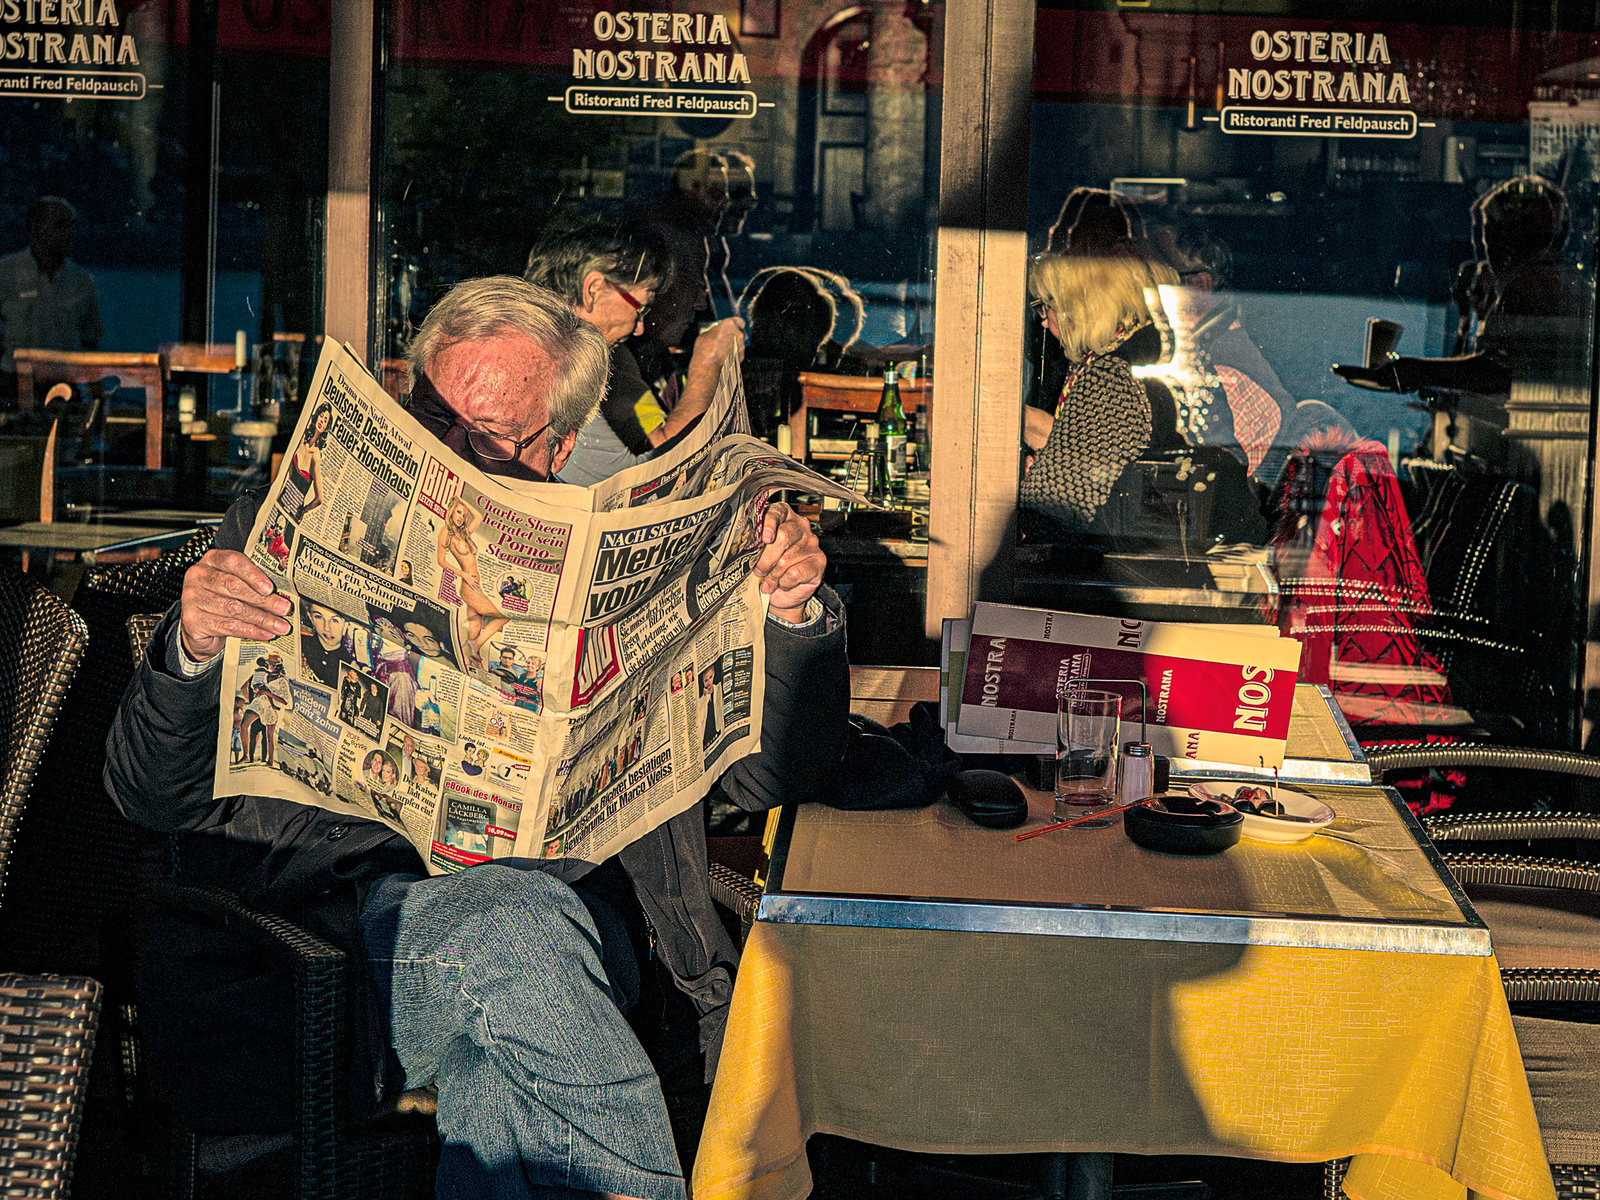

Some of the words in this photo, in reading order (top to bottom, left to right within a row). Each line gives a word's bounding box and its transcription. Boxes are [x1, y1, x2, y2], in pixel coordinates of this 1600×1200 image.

[0, 0, 119, 26] STERIA
[594, 11, 731, 45] OSTERIA
[0, 32, 140, 65] STRANA
[1251, 30, 1391, 64] OSTERIA
[572, 49, 751, 84] NOSTRANA
[33, 77, 62, 89] Fred
[66, 78, 138, 94] Feldpausch
[1228, 68, 1411, 103] NOSTRANA
[575, 93, 640, 108] Ristoranti
[643, 95, 673, 108] Fred
[677, 97, 749, 112] Feldpausch
[1230, 113, 1296, 128] Ristoranti
[1300, 115, 1331, 128] Fred
[1335, 117, 1409, 132] Feldpausch
[324, 376, 364, 428] Deutsche
[363, 417, 419, 476] Designerin
[337, 374, 358, 400] Drama
[358, 399, 368, 412] um
[368, 406, 389, 431] Nadja
[389, 427, 413, 450] Atwal
[332, 416, 412, 498] Feuer-Hochhaus
[477, 495, 523, 525] Charlie
[525, 518, 567, 536] Sheen
[482, 513, 533, 541] heiratet
[536, 535, 564, 548] sein
[497, 533, 555, 559] Porno-
[602, 529, 648, 548] NACH
[486, 544, 560, 575] Sternchen!
[296, 558, 334, 586] Schuss,
[336, 578, 393, 612] Madonna!
[303, 547, 326, 567] Was
[327, 560, 343, 577] für
[344, 572, 361, 585] ein
[363, 581, 414, 610] Schnaps-
[368, 573, 391, 588] ROCCO
[590, 576, 651, 617] vom
[700, 585, 721, 609] etwas
[668, 610, 680, 625] wie
[628, 661, 638, 675] sie
[673, 617, 687, 637] will
[981, 637, 1007, 707] NOSTRA
[1156, 669, 1173, 723] NOSTRANA
[1233, 664, 1275, 732] NOS
[294, 703, 314, 720] ganz
[314, 716, 340, 734] zahm
[458, 733, 476, 746] Liebe
[628, 748, 672, 786] bestätigen
[402, 774, 415, 786] Der
[415, 781, 438, 799] Kaiser
[407, 786, 420, 801] lädt
[421, 795, 435, 809] zum
[445, 781, 471, 795] eBook
[473, 789, 488, 801] des
[490, 794, 521, 811] Monats
[619, 781, 646, 807] Marco
[648, 763, 672, 786] Weiss
[391, 790, 420, 812] Karpfen
[420, 804, 434, 817] ein!
[451, 801, 488, 814] CAMILLA
